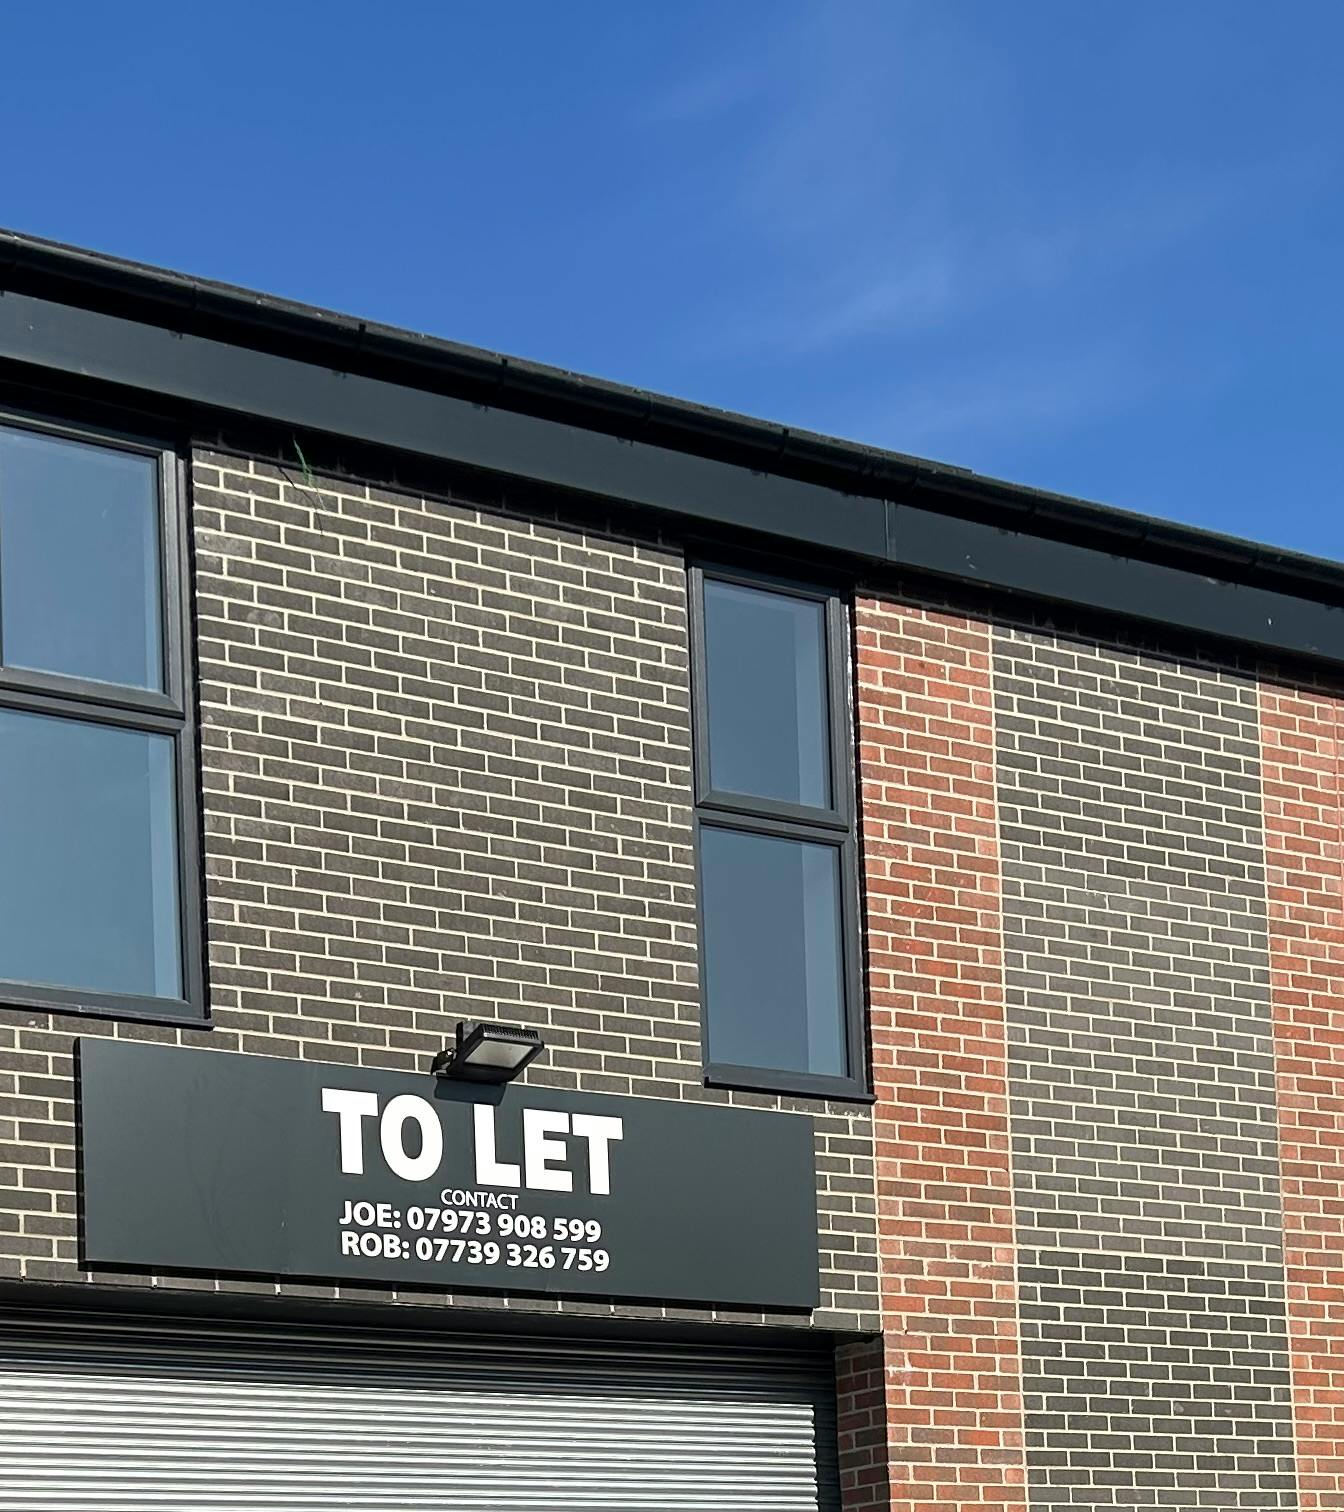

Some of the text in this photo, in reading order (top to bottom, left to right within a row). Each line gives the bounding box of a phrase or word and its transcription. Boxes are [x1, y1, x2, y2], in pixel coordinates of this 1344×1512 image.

[322, 1087, 624, 1195] TO LET
[440, 1189, 519, 1210] CONTACT
[339, 1200, 602, 1243] JOE: 07973 908 599
[341, 1231, 610, 1272] ROB: 07739 326 759
